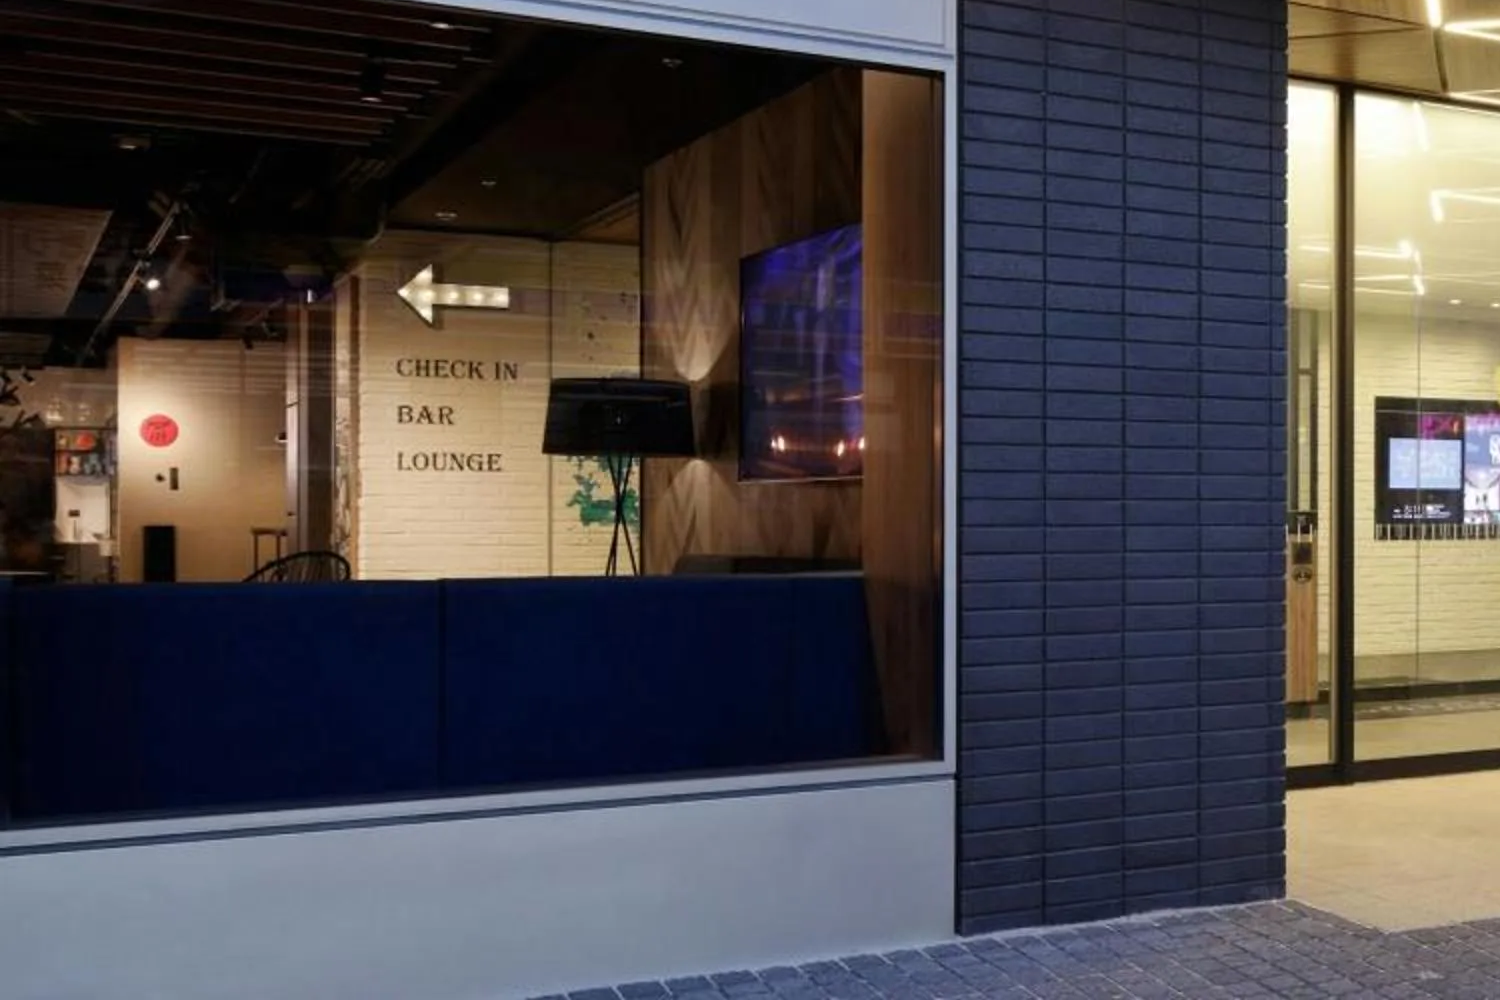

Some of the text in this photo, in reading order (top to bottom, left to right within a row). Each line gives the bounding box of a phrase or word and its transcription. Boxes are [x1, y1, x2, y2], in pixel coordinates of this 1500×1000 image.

[396, 358, 519, 381] CHECK IN
[397, 404, 455, 425] BAR
[397, 451, 503, 472] LOUNGE
